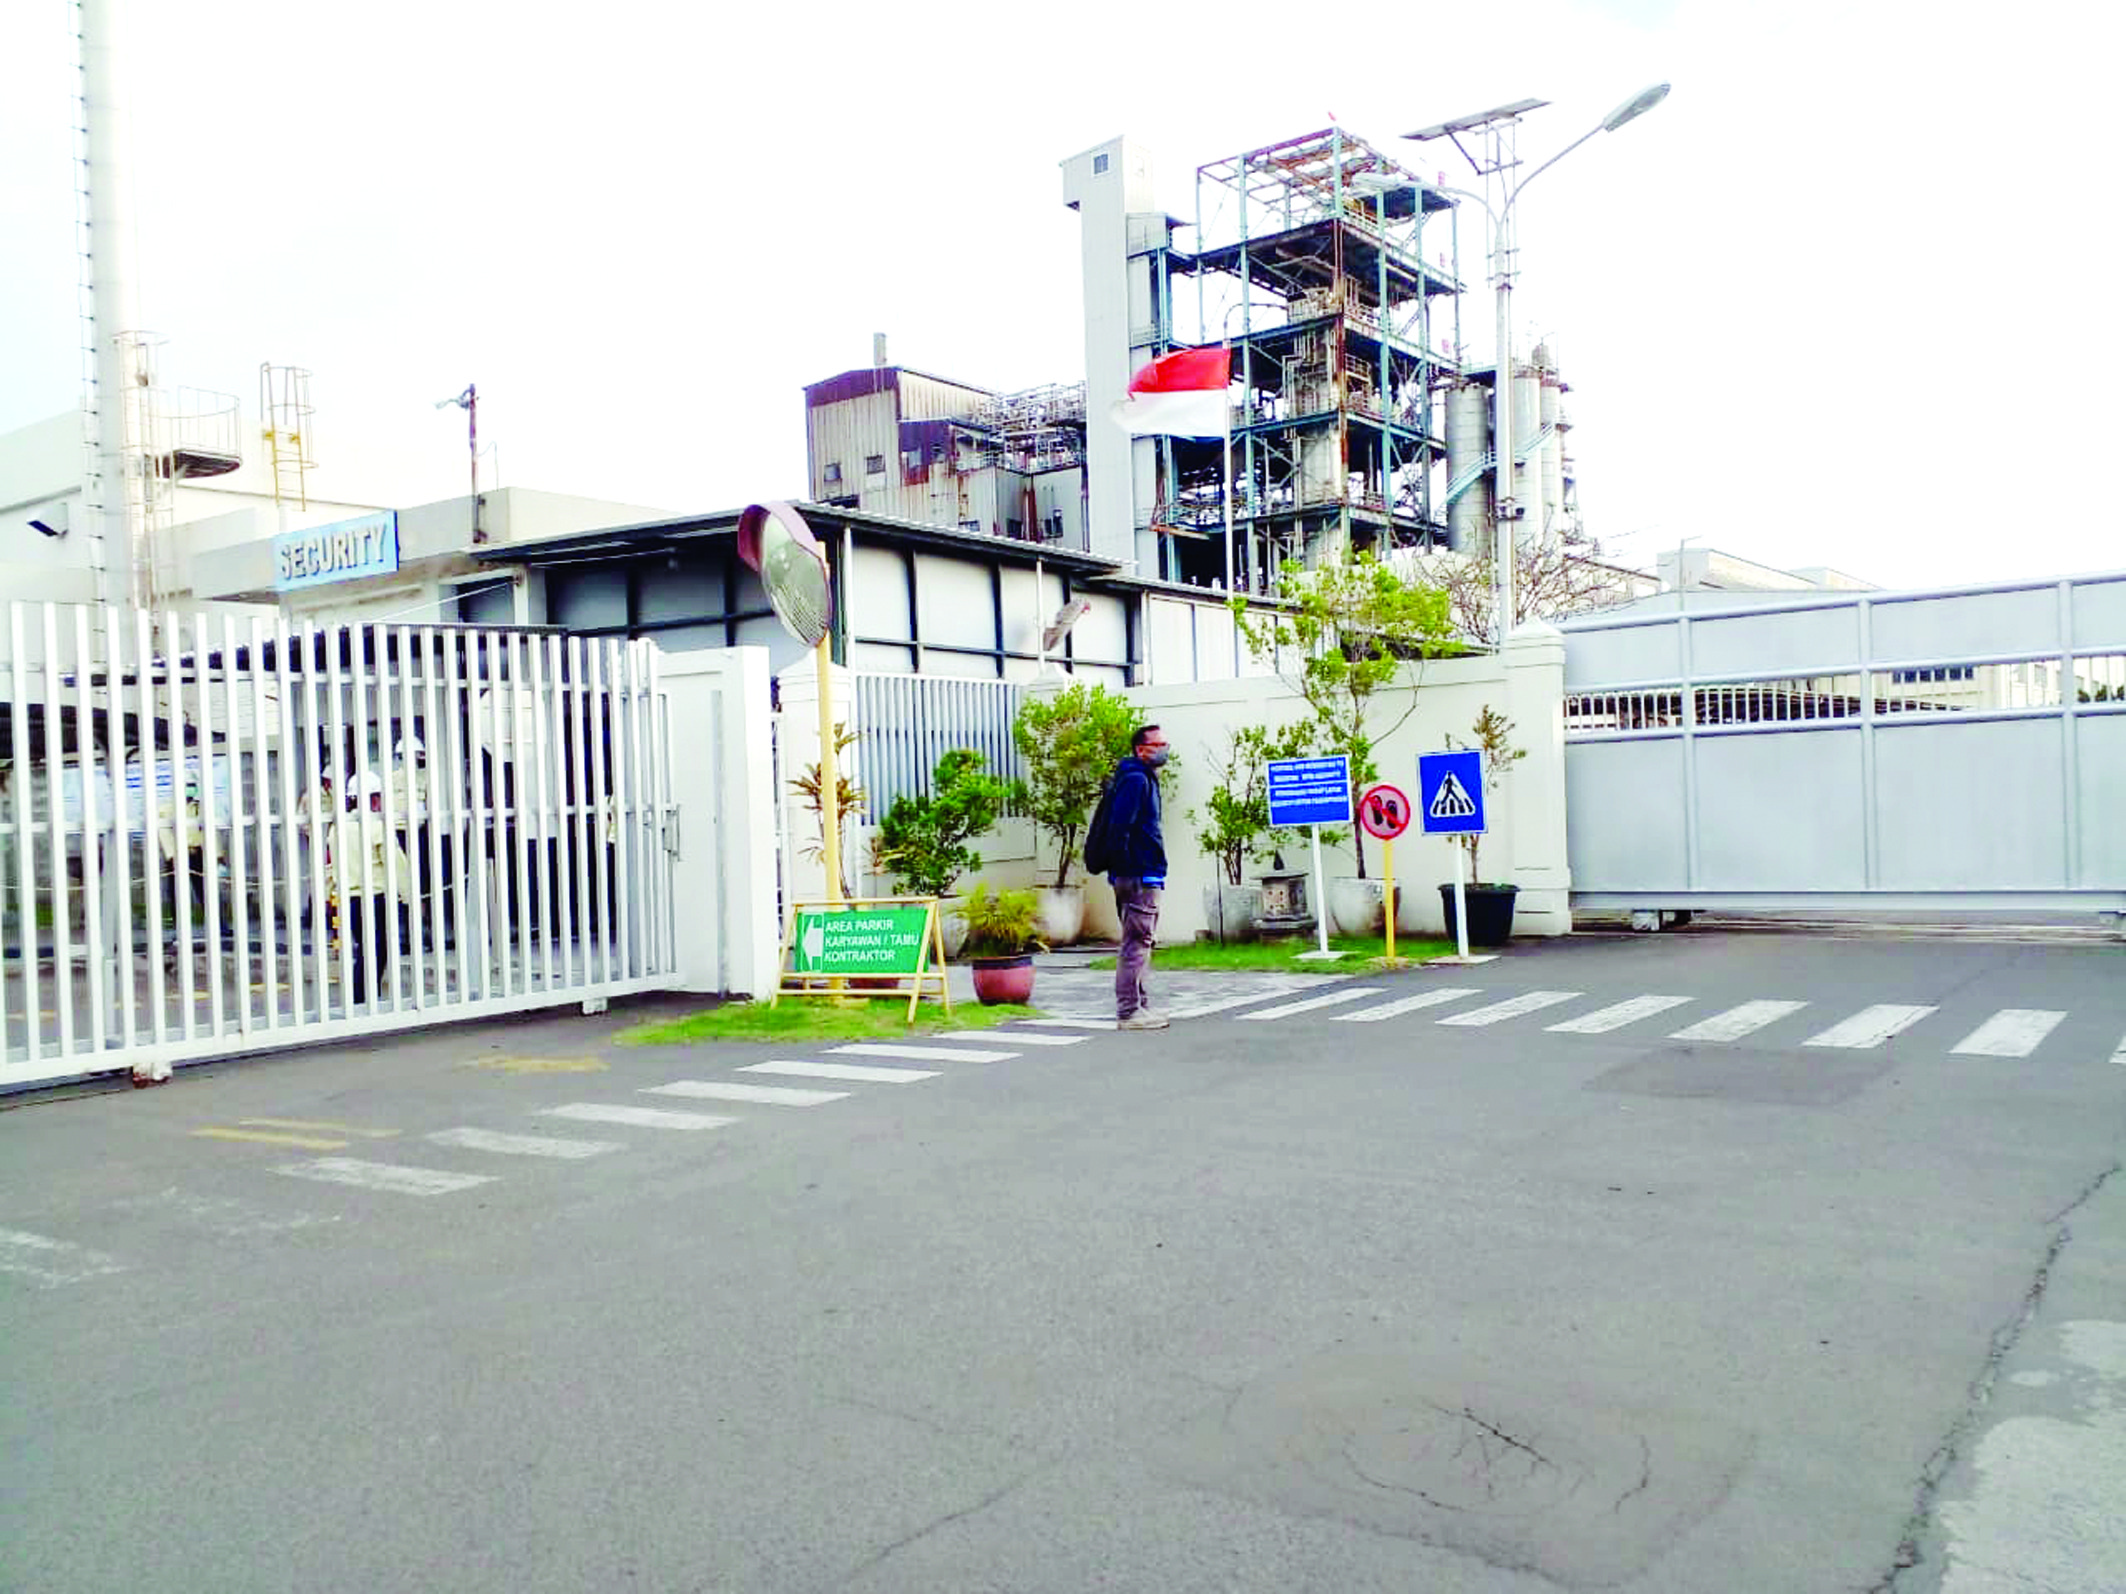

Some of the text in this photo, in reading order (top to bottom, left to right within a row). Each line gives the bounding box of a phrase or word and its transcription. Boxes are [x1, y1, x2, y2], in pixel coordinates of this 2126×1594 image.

[281, 522, 387, 581] SECURITY
[825, 919, 894, 932] AREA PARKIR
[825, 934, 881, 947] KARYAWAN
[890, 933, 920, 946] TAMU
[824, 949, 896, 962] KONTRAKTOR
